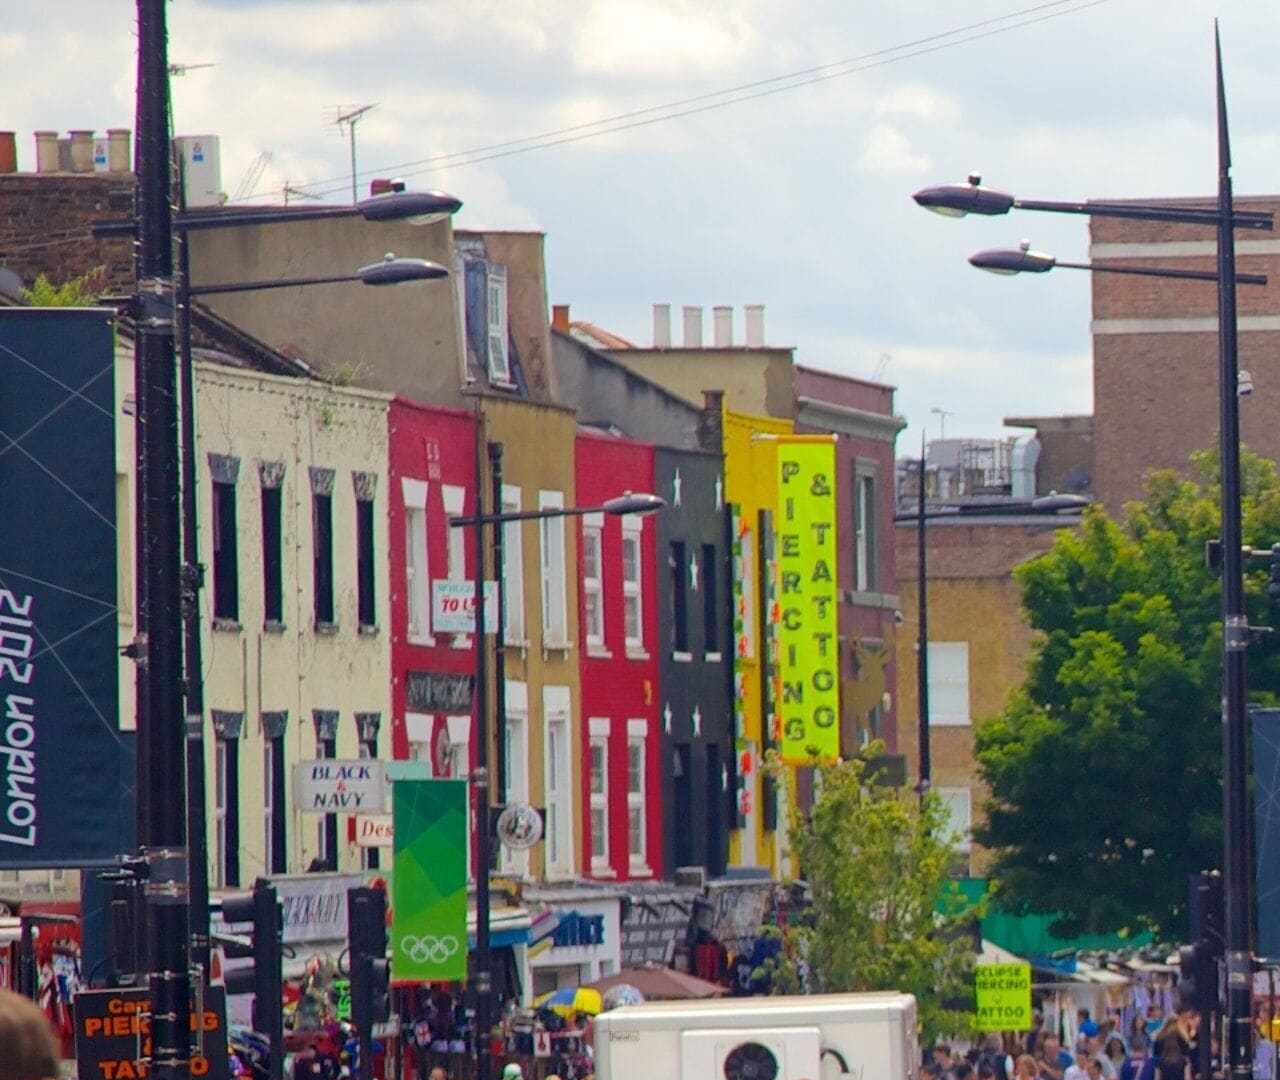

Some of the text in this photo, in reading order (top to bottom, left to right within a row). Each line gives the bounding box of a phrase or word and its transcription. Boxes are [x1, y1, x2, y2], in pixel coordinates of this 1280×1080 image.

[811, 522, 835, 729] TATTOO
[0, 696, 37, 846] London
[312, 766, 371, 779] BLACK
[313, 793, 365, 808] NAVY
